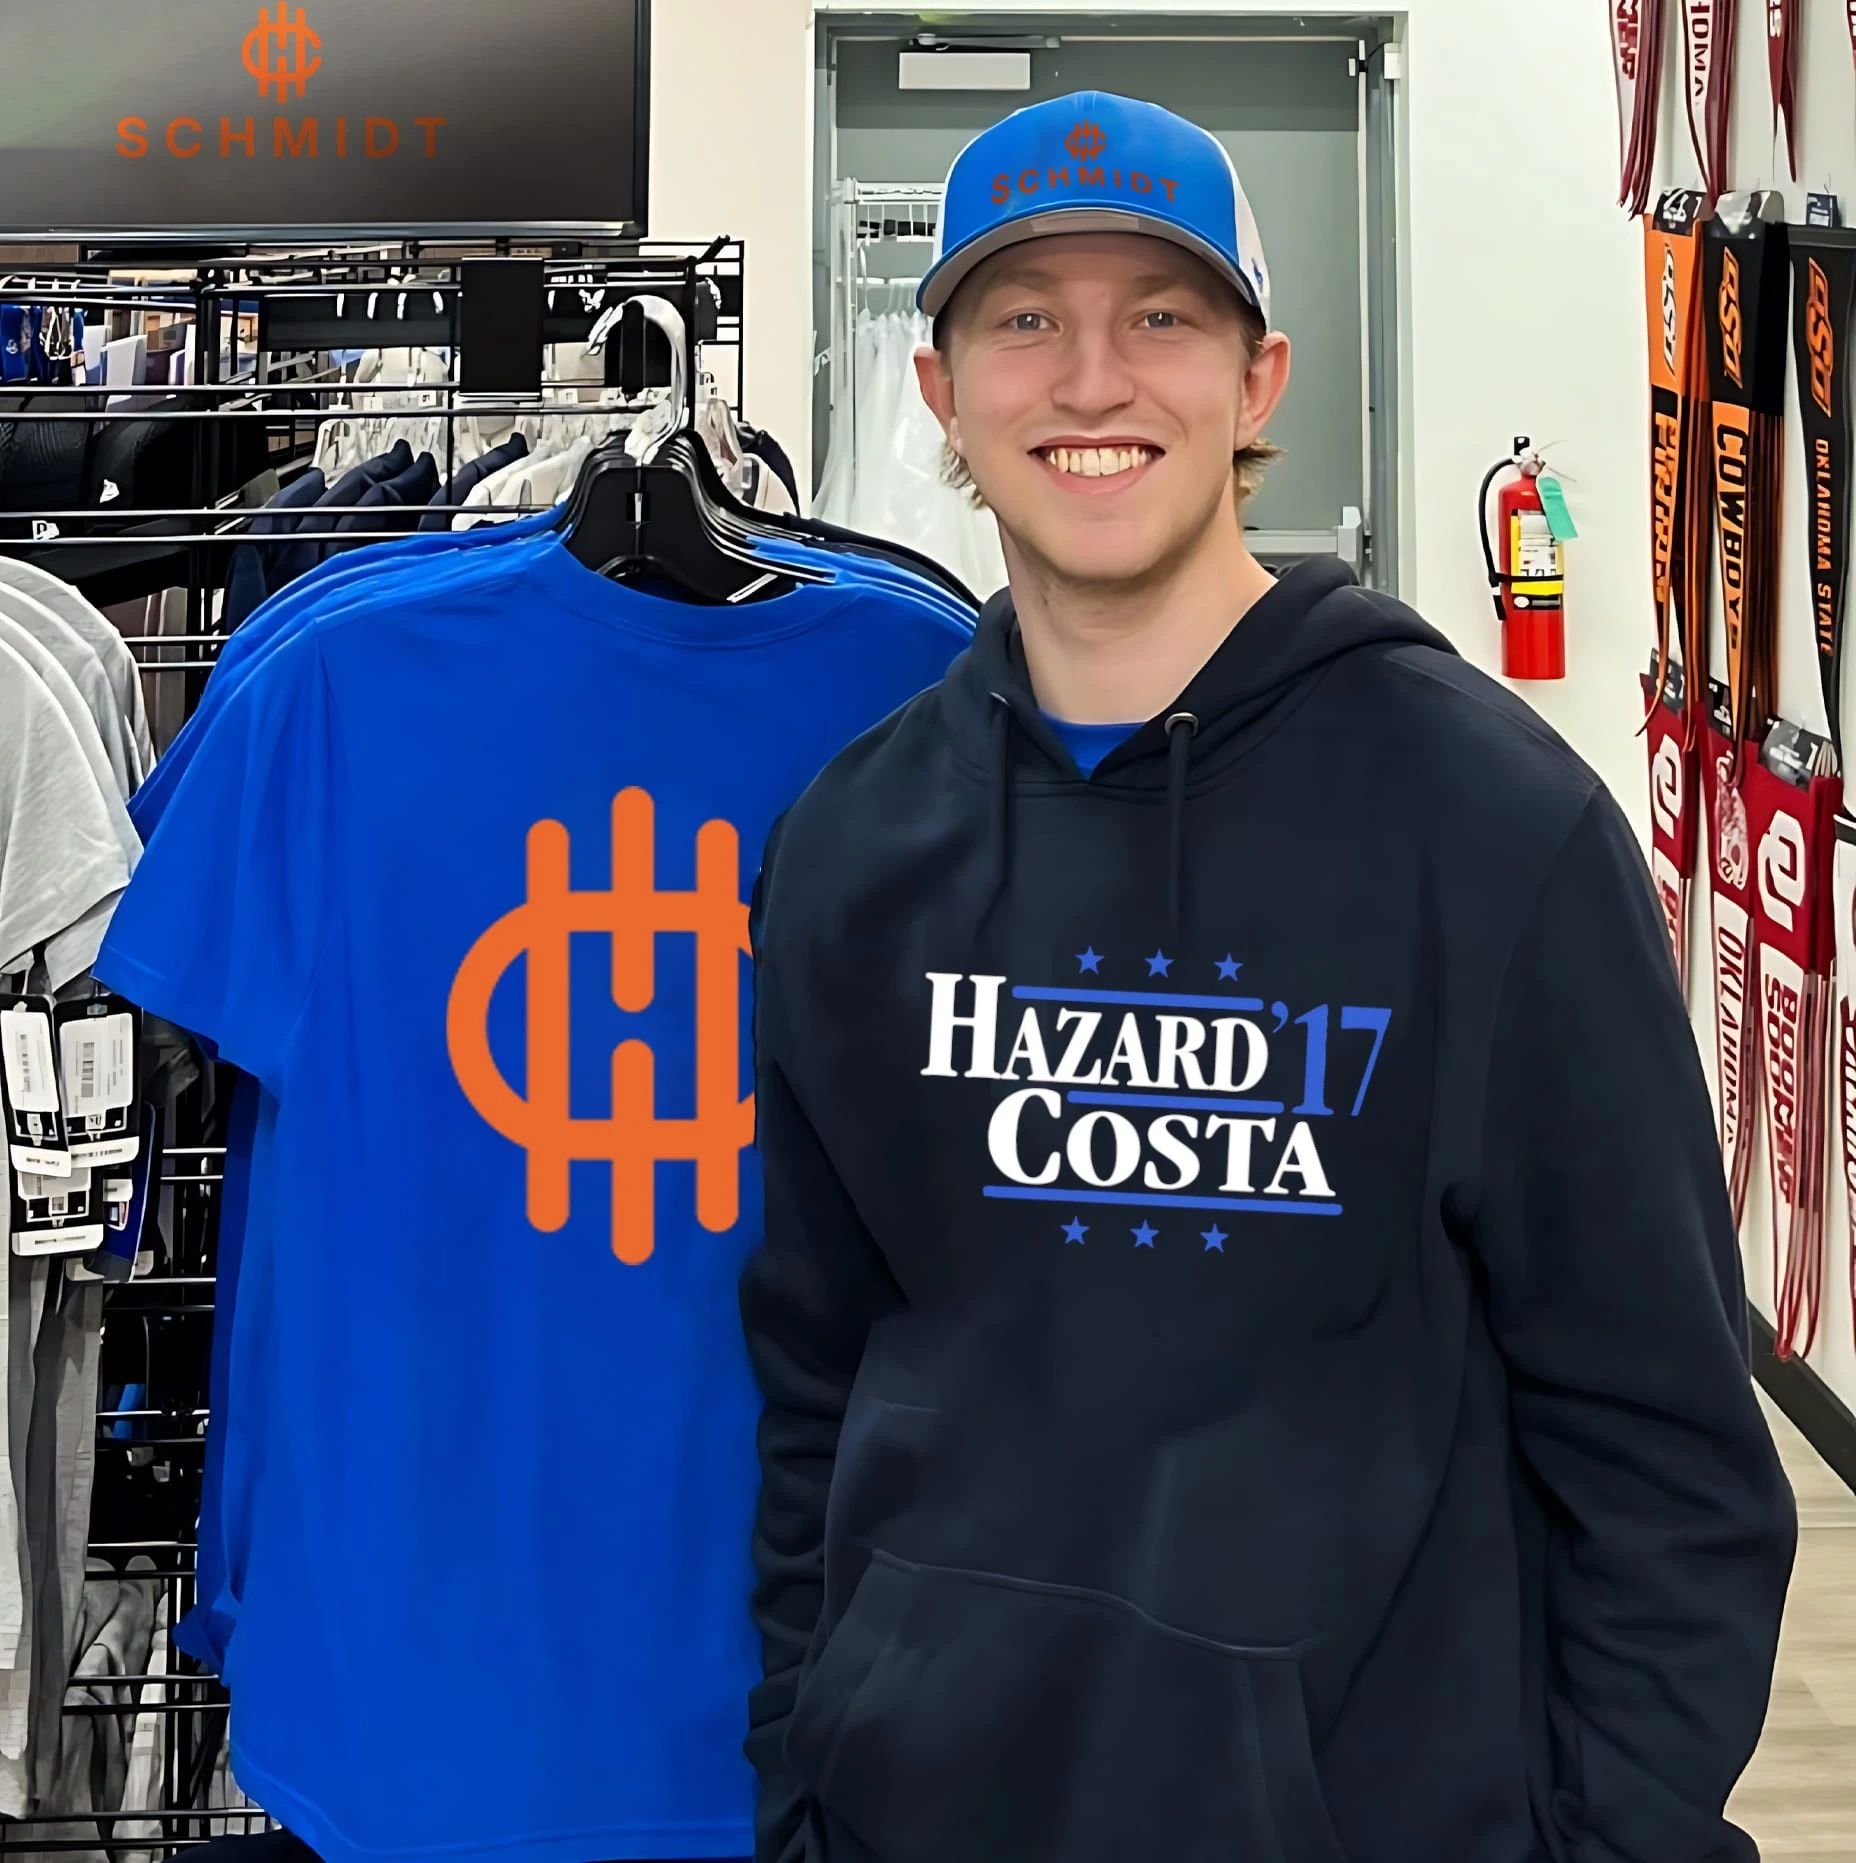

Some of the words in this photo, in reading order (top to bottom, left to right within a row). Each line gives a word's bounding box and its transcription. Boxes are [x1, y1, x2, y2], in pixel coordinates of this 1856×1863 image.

[116, 116, 447, 158] SCHMIDT
[991, 166, 1180, 204] SCHMIDT
[1815, 438, 1832, 570] OKLAHOMA
[1816, 583, 1834, 656] STATE
[920, 971, 1269, 1093] HAZARD
[1271, 1000, 1392, 1117] '17
[1717, 925, 1745, 1144] OKLAHOMA
[987, 1087, 1336, 1196] COSTA
